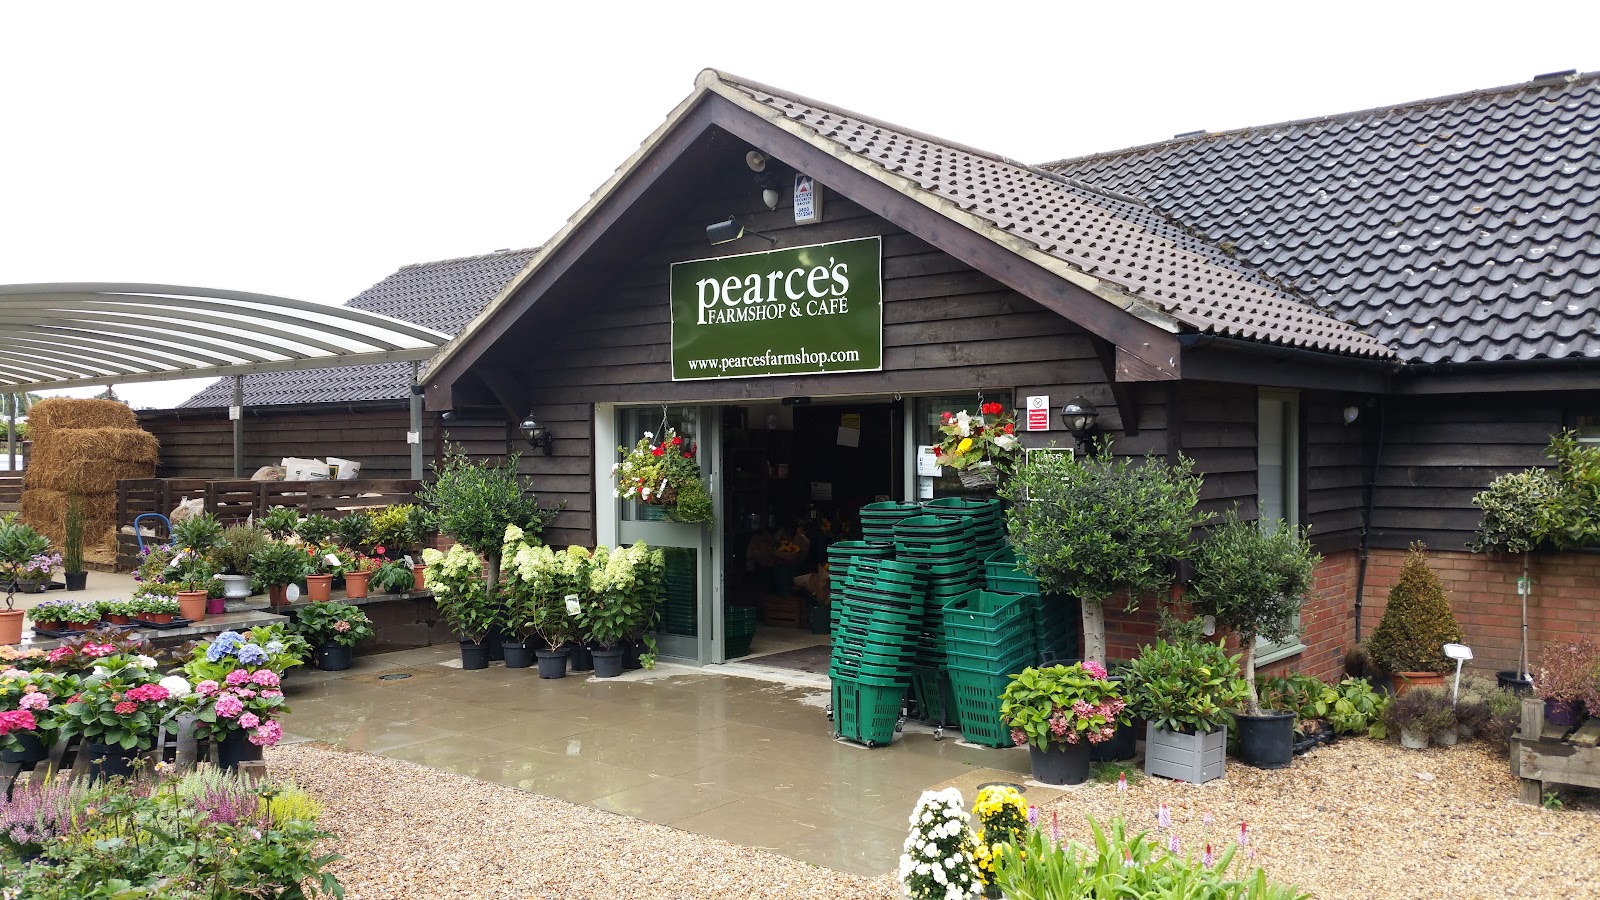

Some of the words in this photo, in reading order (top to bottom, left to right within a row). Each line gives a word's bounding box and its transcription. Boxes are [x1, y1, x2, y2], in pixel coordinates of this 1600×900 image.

[695, 256, 850, 325] pearce's
[707, 303, 787, 324] FARMSHOP
[789, 302, 803, 317] &
[806, 296, 849, 316] CAFÉ
[688, 347, 859, 372] www.pearcesfarmshop.com
